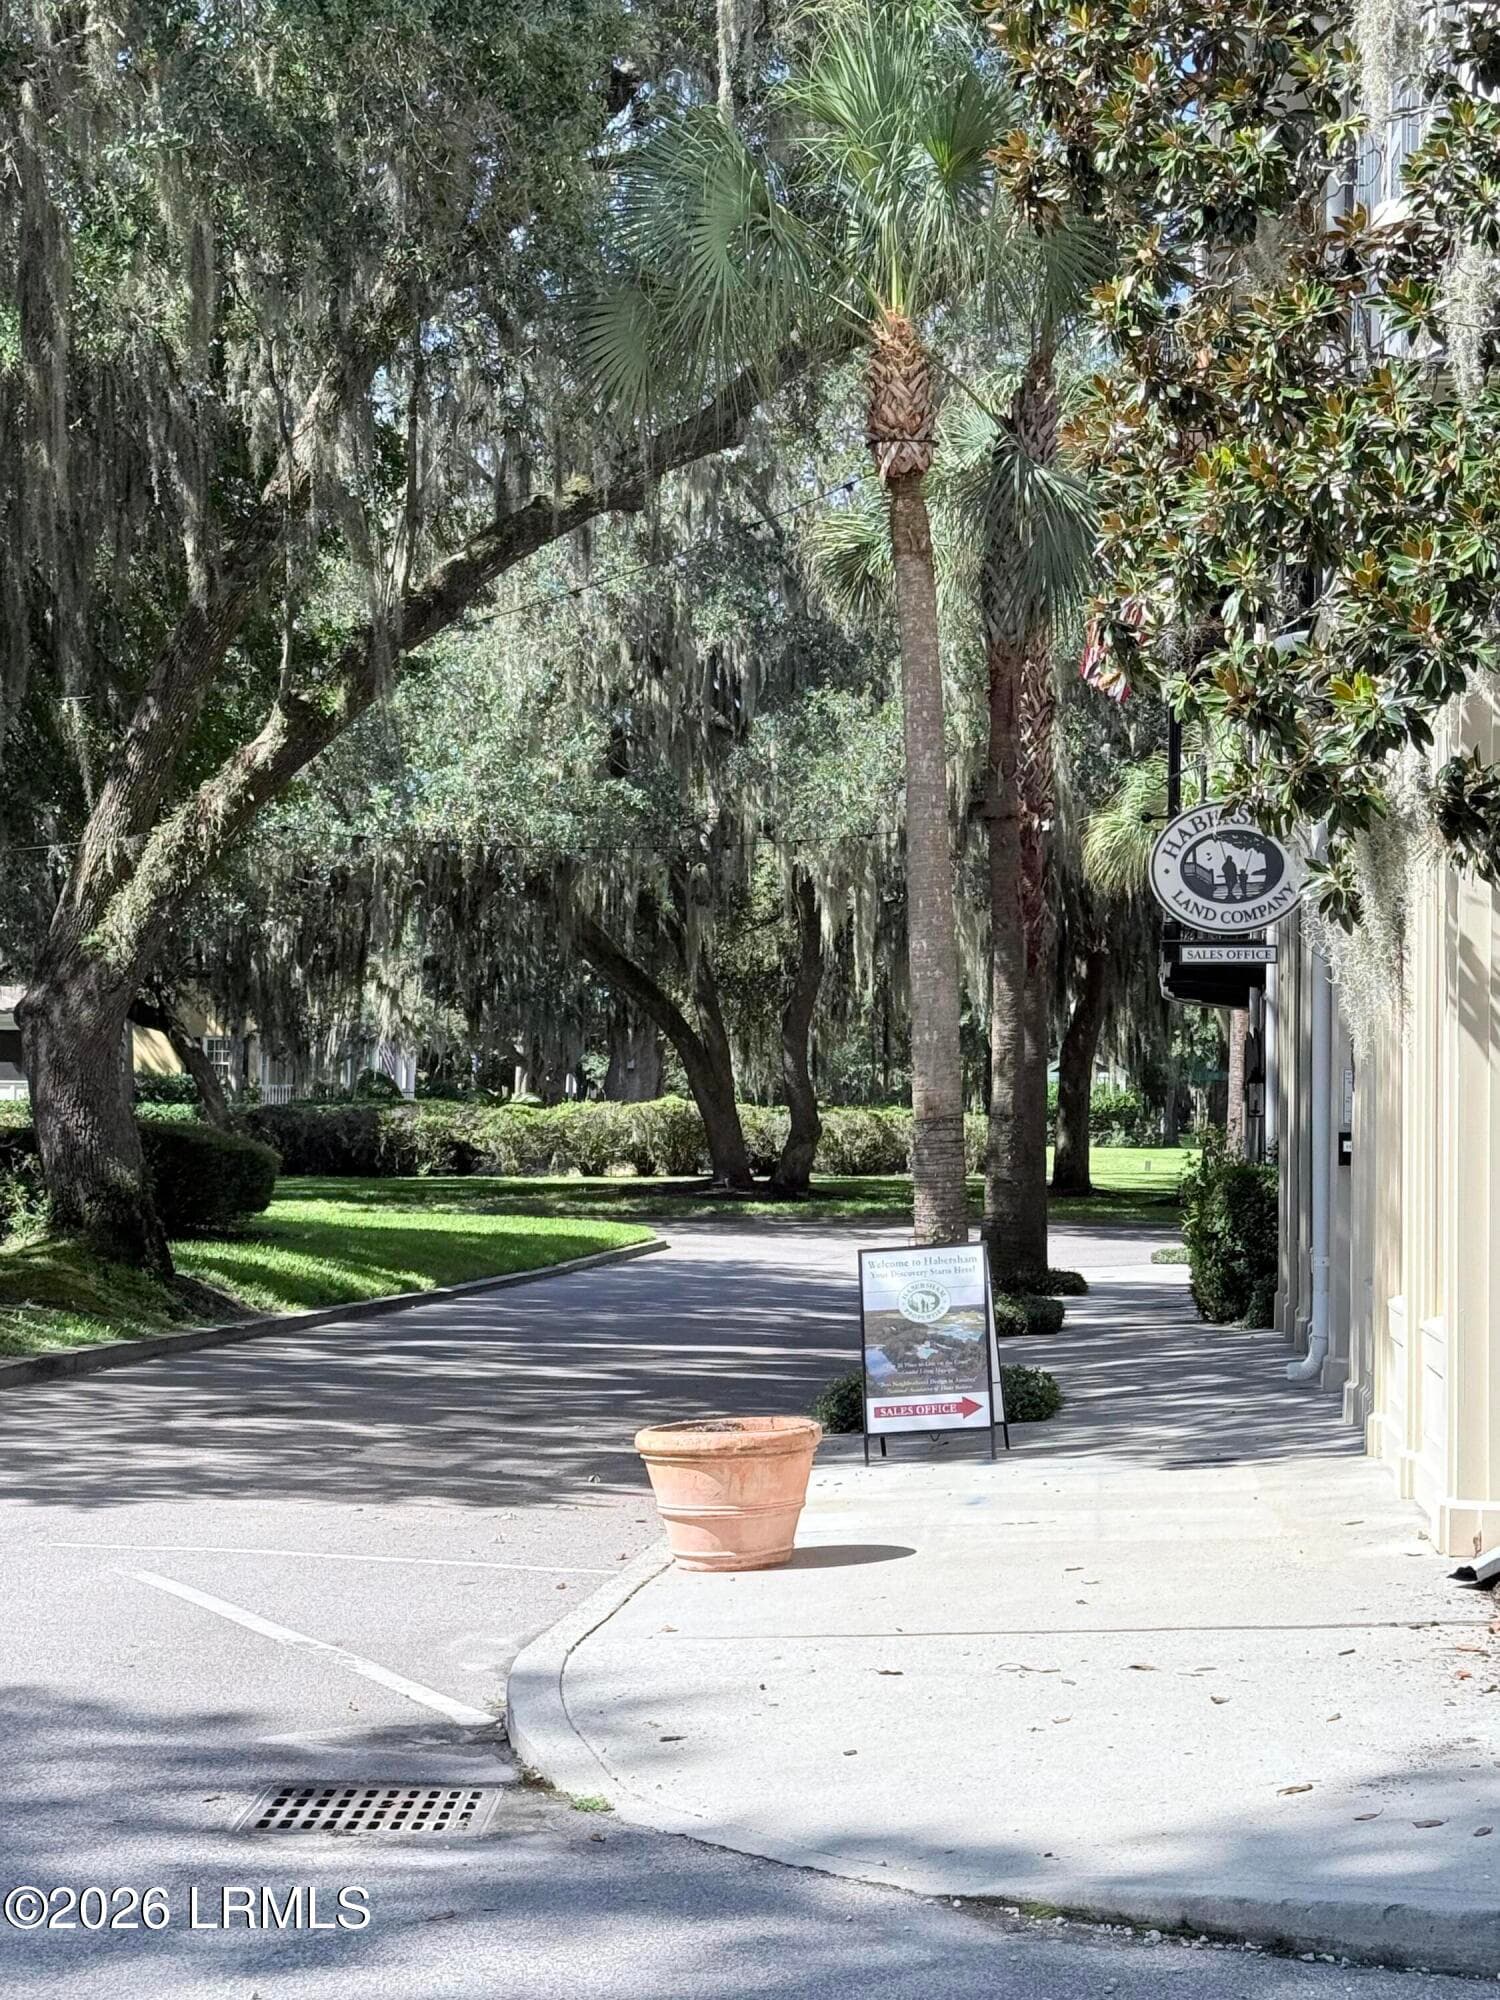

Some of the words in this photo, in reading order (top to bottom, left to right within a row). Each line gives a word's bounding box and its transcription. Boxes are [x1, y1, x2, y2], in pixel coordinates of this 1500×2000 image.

[1171, 889, 1217, 921] LAND
[1220, 881, 1296, 924] COMPANY
[1187, 949, 1223, 960] SALES
[1226, 949, 1272, 960] OFFICE
[868, 1259, 909, 1269] Welcome
[912, 1259, 921, 1267] to
[924, 1255, 977, 1266] Habersham
[890, 1270, 928, 1278] Discovery
[880, 1406, 914, 1417] SALES
[916, 1404, 957, 1415] OFFICE
